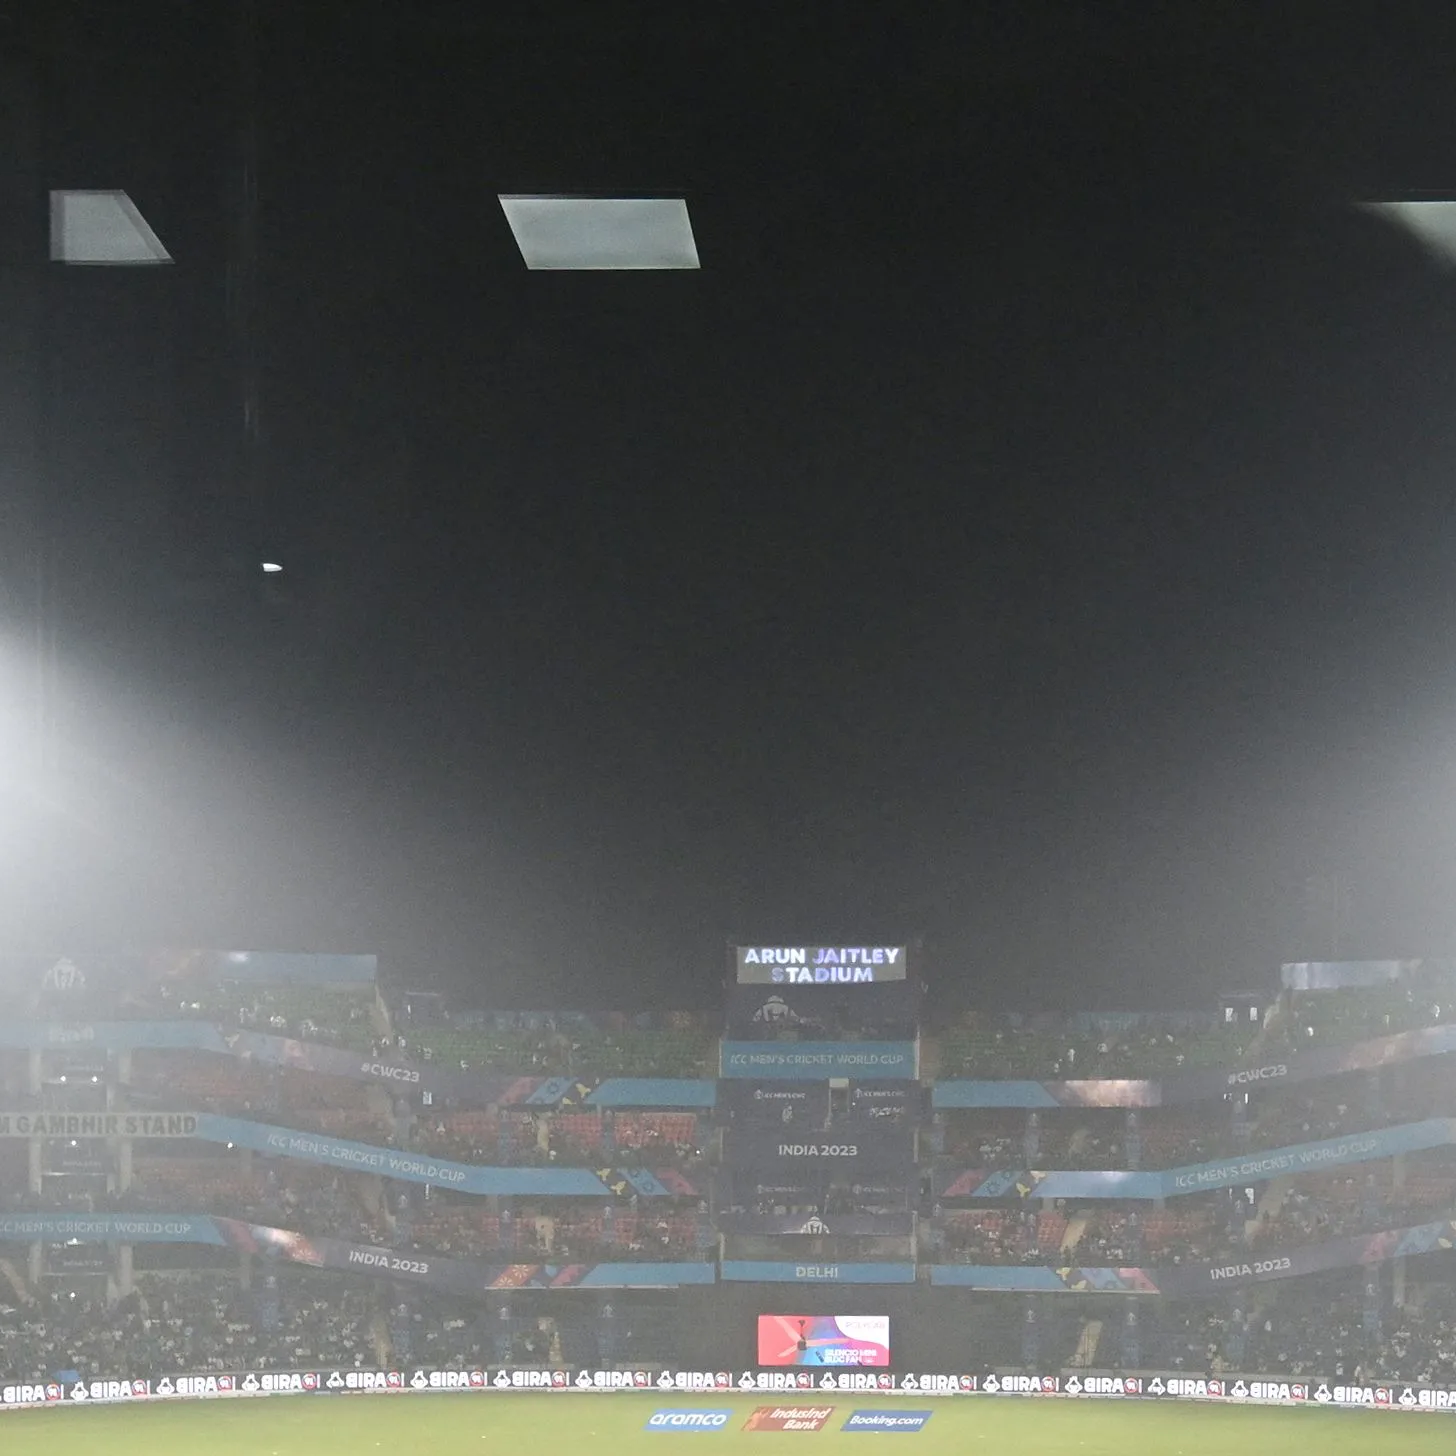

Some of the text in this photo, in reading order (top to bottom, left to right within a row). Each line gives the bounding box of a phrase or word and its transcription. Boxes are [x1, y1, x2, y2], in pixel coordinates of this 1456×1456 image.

[745, 948, 898, 964] ARUN JAITLEY
[772, 967, 872, 982] STADIUM
[731, 1054, 904, 1064] ICC MEN'S CRICKET WORLD CUP
[360, 1062, 420, 1082] #CWC23
[1228, 1064, 1287, 1084] #CWC23
[16, 1115, 118, 1133] GAMBHIR
[125, 1115, 196, 1134] STAND
[778, 1145, 857, 1155] INDIA 2023
[267, 1134, 466, 1183] ICC MEN'S CRICKET WORLD CUP
[1175, 1140, 1377, 1187] ICC MEN'S CRICKET WORLD CUP
[15, 1222, 54, 1232] MEN'S
[56, 1222, 109, 1232] CRICKET
[115, 1222, 161, 1233] WORLD
[165, 1223, 191, 1234] CUP
[349, 1251, 429, 1274] INDIA 2023
[1210, 1258, 1291, 1280] INDIA 2023
[796, 1266, 838, 1278] DELHI
[346, 1372, 386, 1388] BIRA
[675, 1372, 714, 1387] BIRA
[1001, 1376, 1041, 1392] BIRA
[3, 1385, 44, 1402] BIRA
[1334, 1386, 1374, 1403] BIRA
[650, 1413, 727, 1426] aramco
[770, 1408, 830, 1420] IndusInd
[849, 1415, 924, 1428] Booking.com
[782, 1419, 819, 1430] Bank
